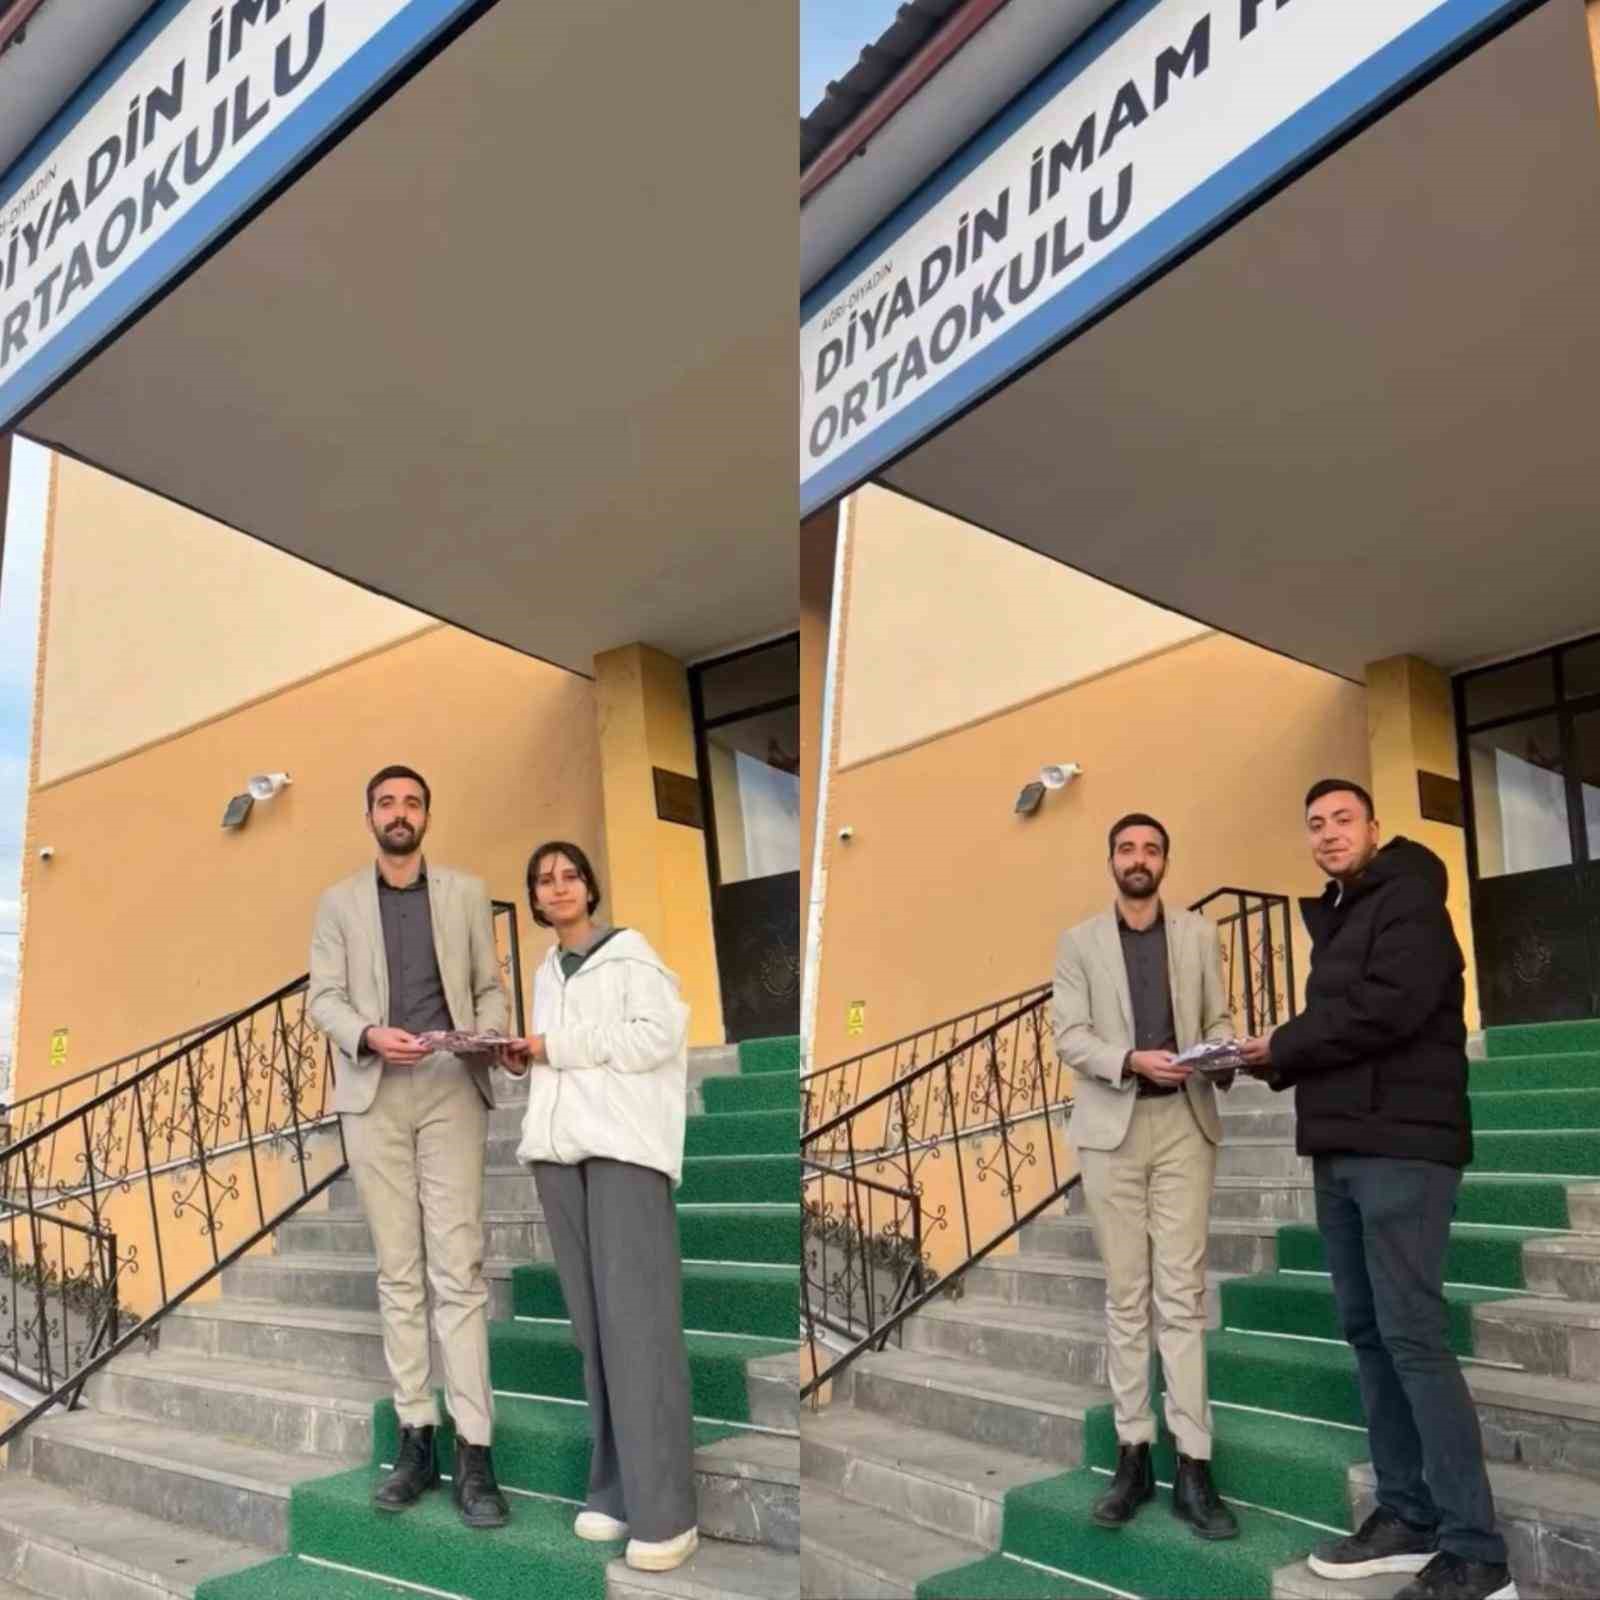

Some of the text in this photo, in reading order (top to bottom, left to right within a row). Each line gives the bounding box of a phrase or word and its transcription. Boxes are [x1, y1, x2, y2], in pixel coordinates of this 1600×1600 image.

[0, 0, 290, 290] İYADİN İM
[815, 13, 1210, 393] DİYADİN İMAM
[808, 162, 1133, 458] ORTAOKULU
